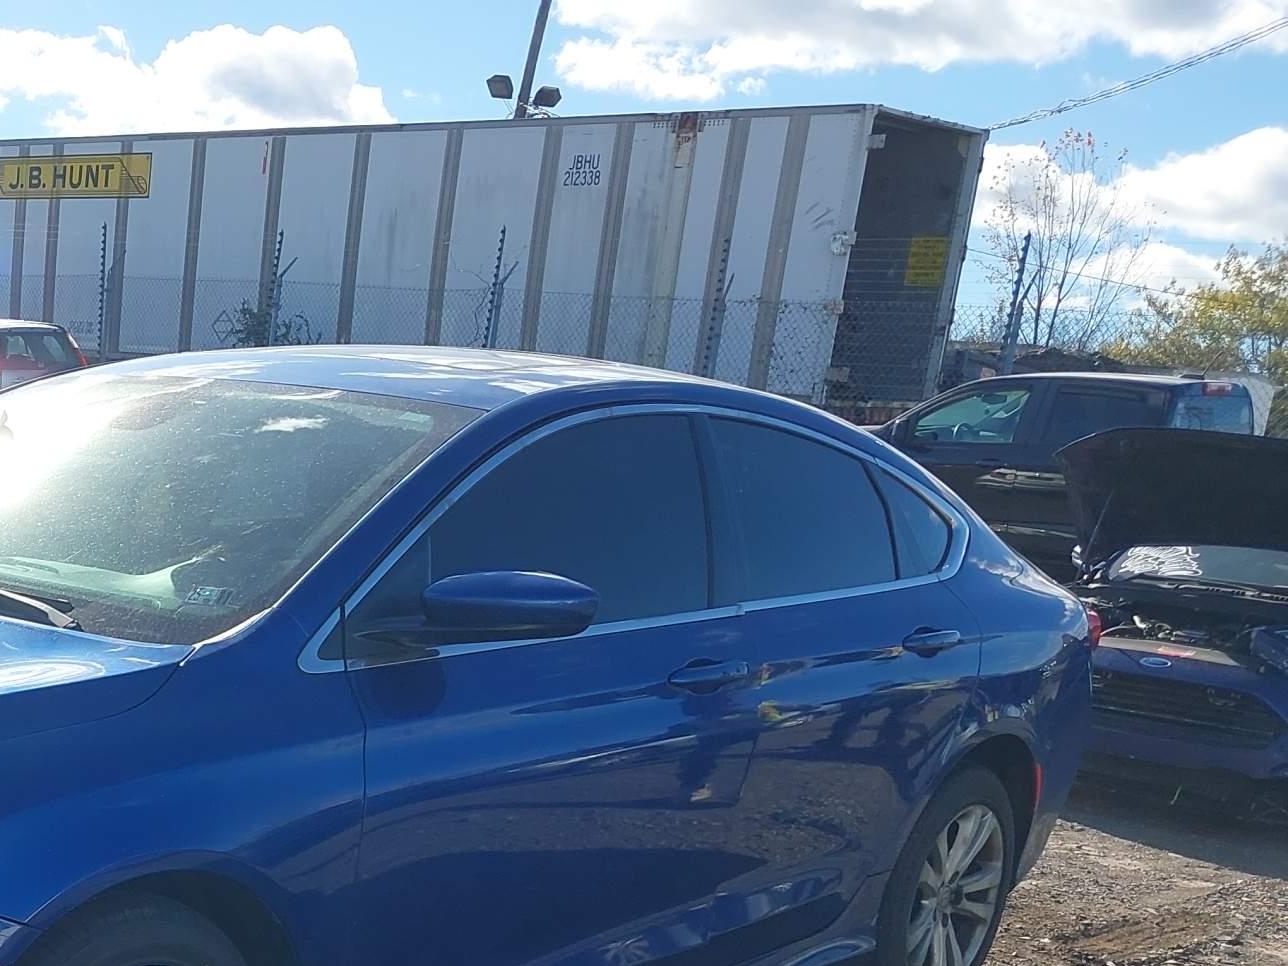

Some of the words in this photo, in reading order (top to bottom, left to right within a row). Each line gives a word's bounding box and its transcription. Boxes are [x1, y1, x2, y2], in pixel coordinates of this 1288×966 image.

[569, 154, 601, 170] JBHU
[9, 165, 46, 190] J.B.
[52, 163, 115, 189] HUNT
[563, 170, 601, 186] 212338
